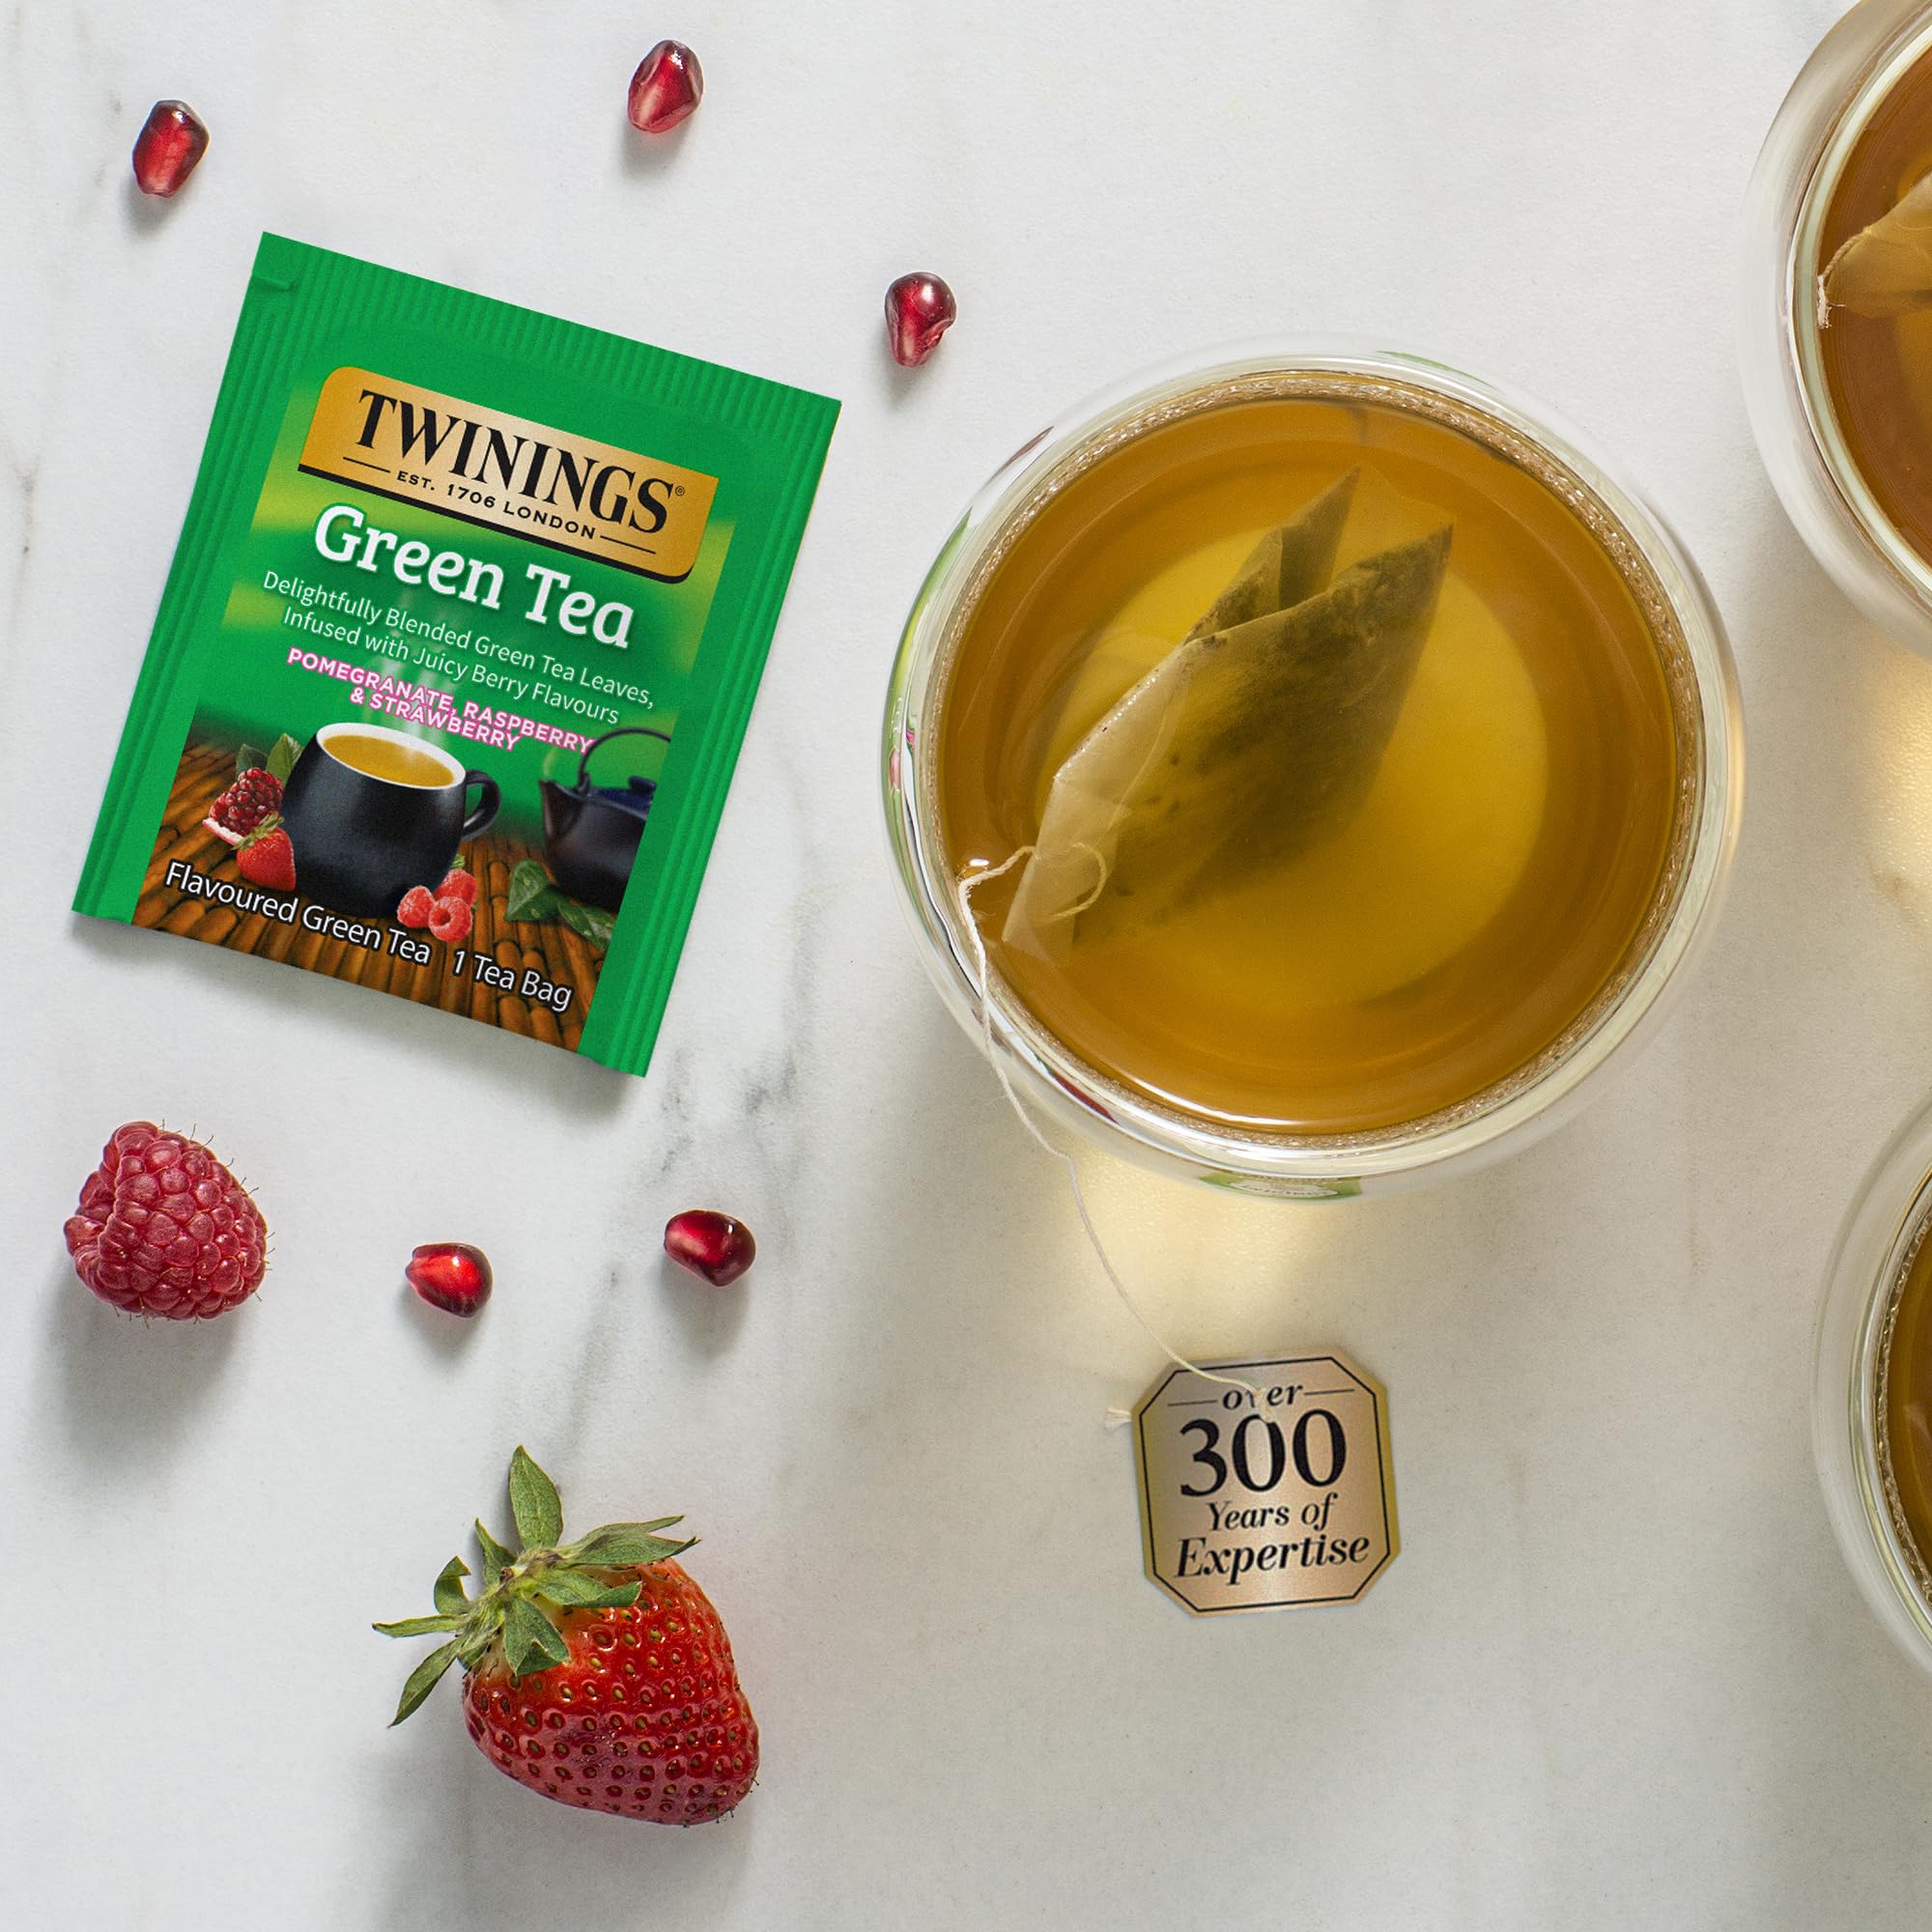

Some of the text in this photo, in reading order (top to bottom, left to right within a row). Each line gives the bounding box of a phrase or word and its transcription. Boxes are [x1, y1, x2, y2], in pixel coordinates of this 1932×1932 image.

[397, 470, 596, 540] EST. 1706 LONDON
[315, 505, 635, 648] Green Tea
[263, 571, 655, 708] Delightfully Blended Green Tea Leaves,
[283, 607, 620, 724] Infused with Juicy Berry Flavours
[288, 648, 595, 753] POMEGRANATE, RASPBERRY
[350, 687, 522, 752] & STRAWBERRY
[166, 862, 572, 1012] Flavoured Green Tea 1 Tea Bag
[1179, 1408, 1347, 1497] 300
[1174, 1534, 1370, 1586] Expertise
[1208, 1492, 1339, 1531] Years of
